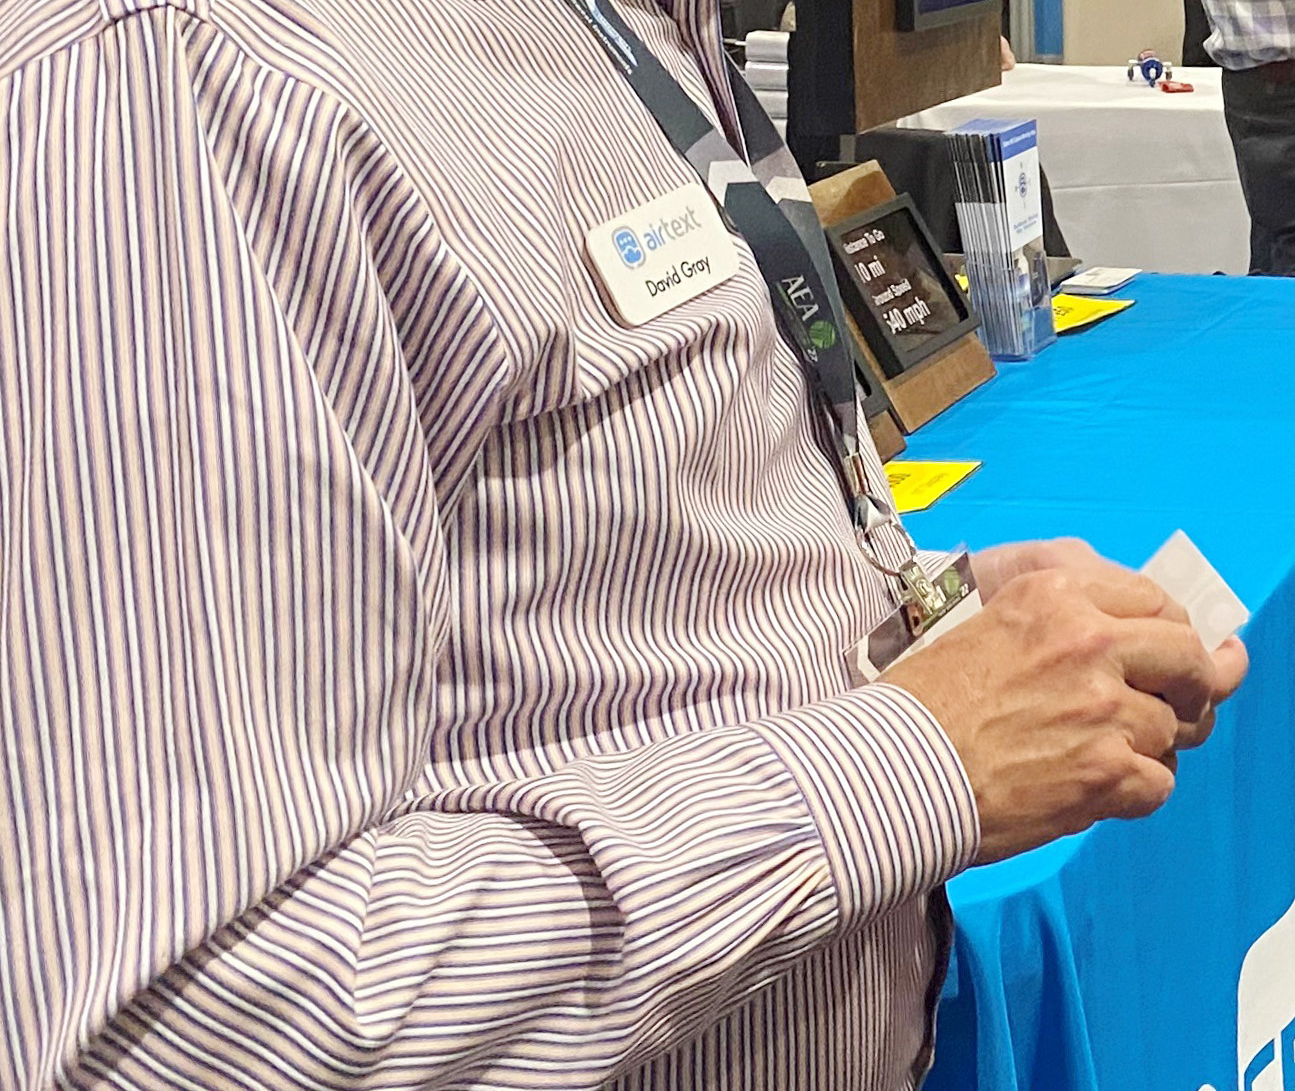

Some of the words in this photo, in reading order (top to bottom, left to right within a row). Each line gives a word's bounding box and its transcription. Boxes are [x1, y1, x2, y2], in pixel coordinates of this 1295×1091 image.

[643, 206, 702, 250] airtext
[645, 265, 682, 297] David
[680, 256, 711, 278] Gray
[868, 255, 886, 278] mi
[781, 274, 820, 322] AEA
[903, 296, 931, 325] mph
